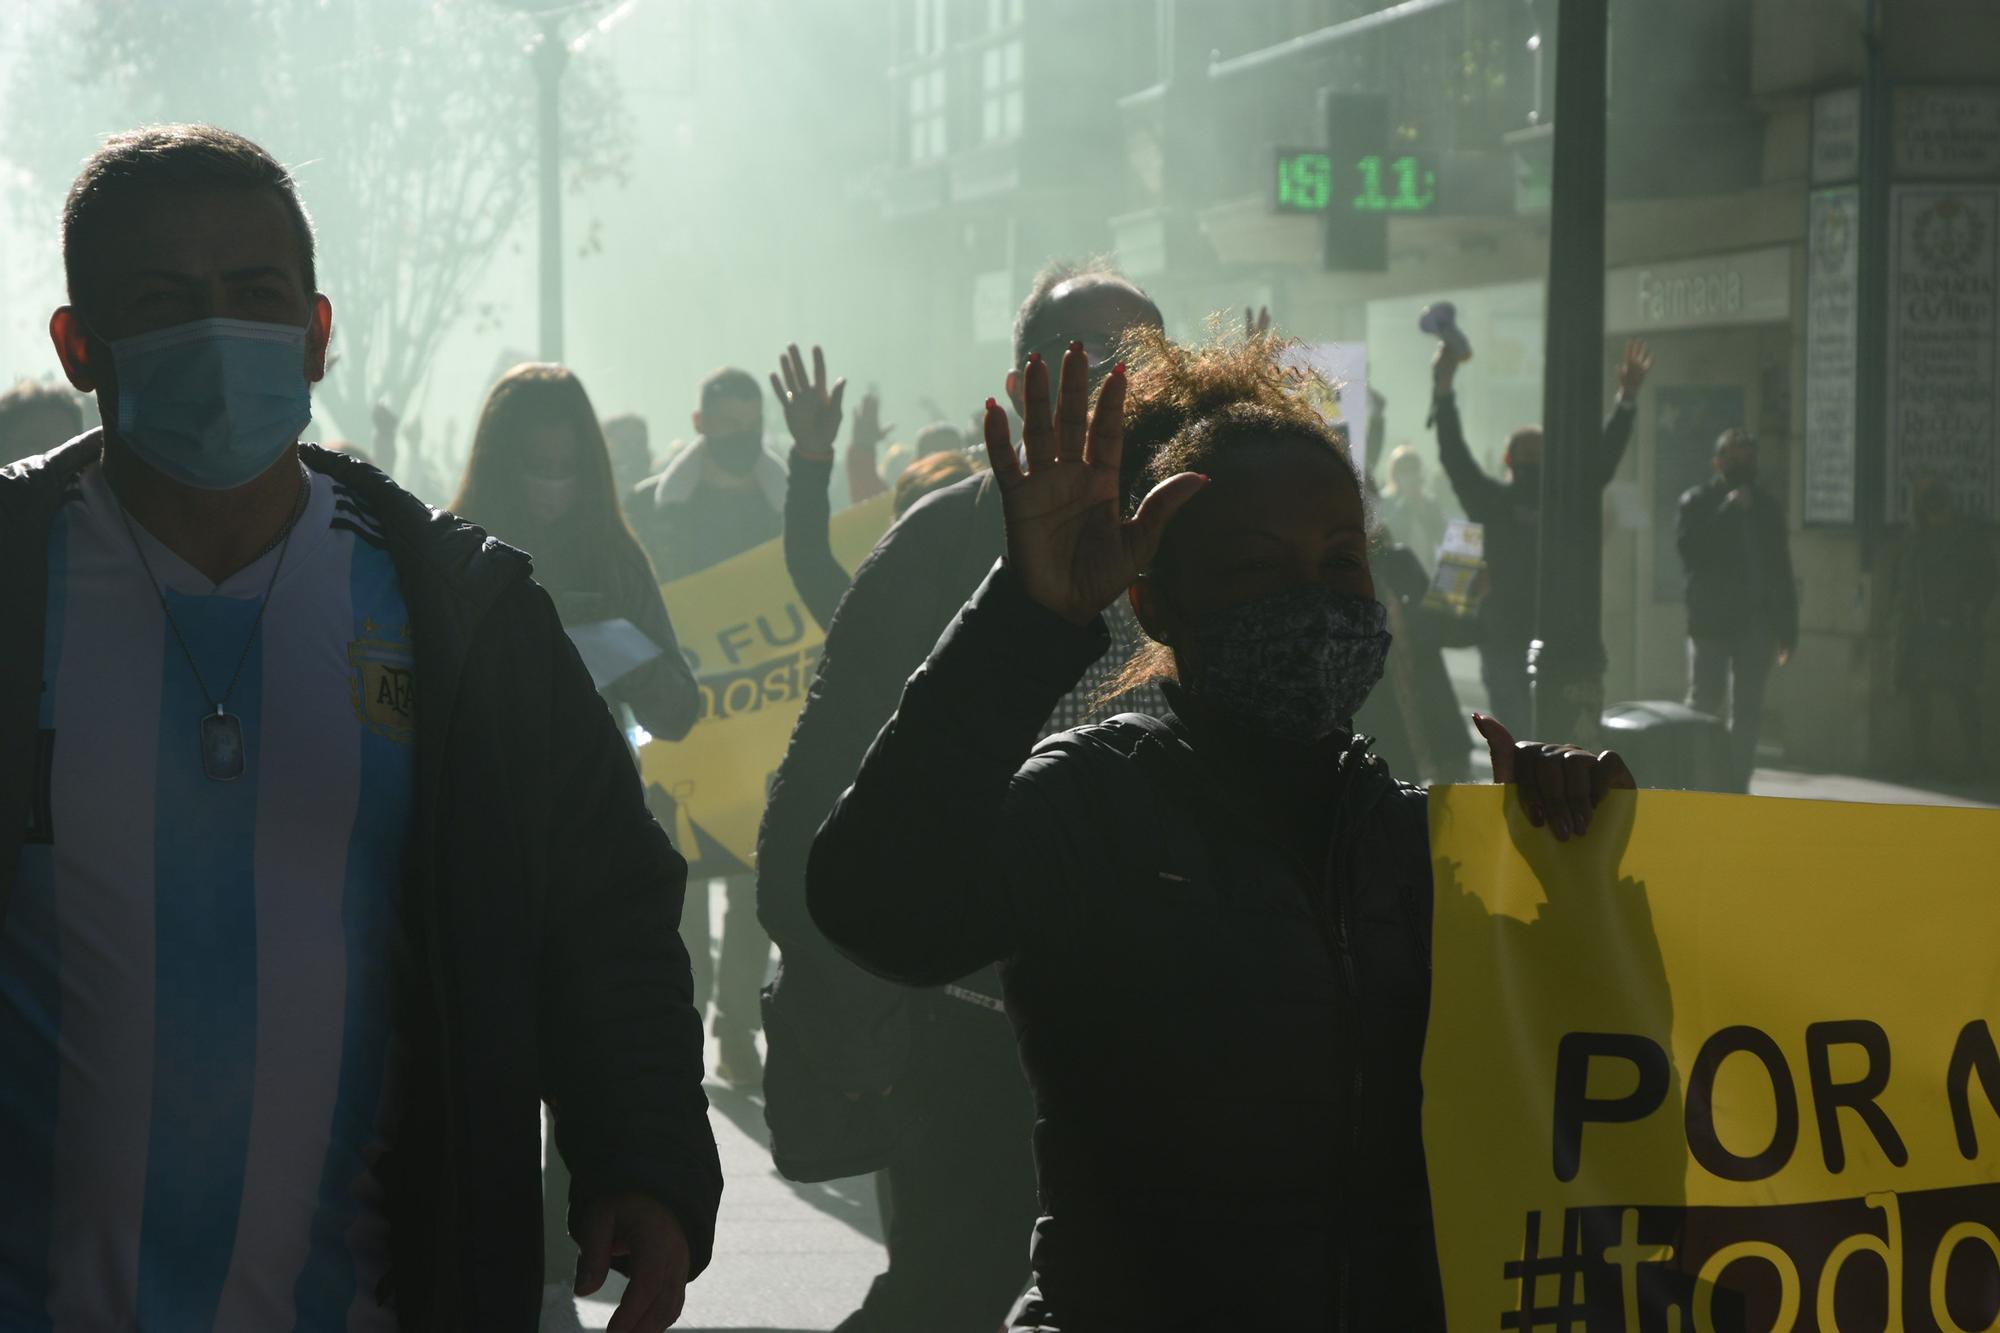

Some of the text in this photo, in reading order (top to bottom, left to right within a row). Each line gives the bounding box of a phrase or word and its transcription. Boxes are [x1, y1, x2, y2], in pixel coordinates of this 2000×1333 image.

[1638, 270, 1744, 321] Farmacia
[377, 665, 416, 717] AFA
[1552, 1019, 1910, 1184] POR
[1500, 1191, 2000, 1333] #todo
